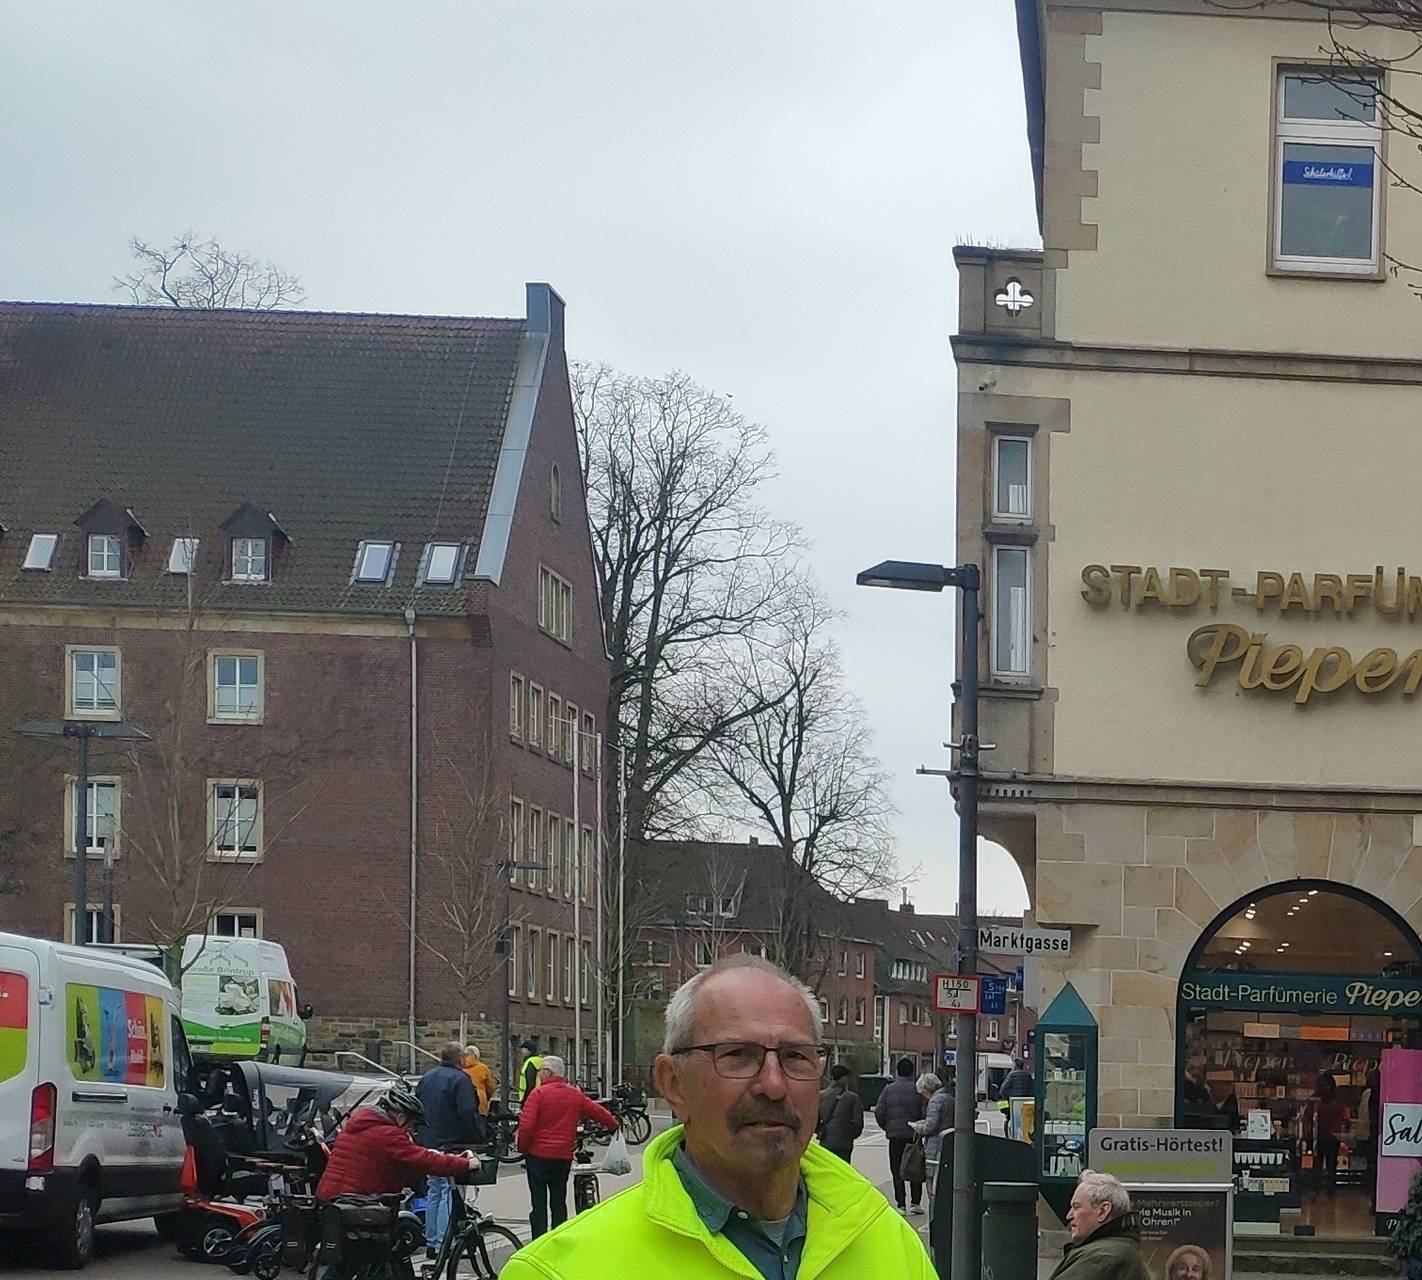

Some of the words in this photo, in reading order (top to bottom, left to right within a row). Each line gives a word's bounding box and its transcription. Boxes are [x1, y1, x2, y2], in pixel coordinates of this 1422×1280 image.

[979, 930, 1070, 954] Marktgasse
[1181, 983, 1338, 1005] Stadt-Parfümerie
[1100, 1137, 1224, 1152] Gratis-Hörtest!
[1152, 1207, 1180, 1217] Musik
[1182, 1207, 1192, 1217] in
